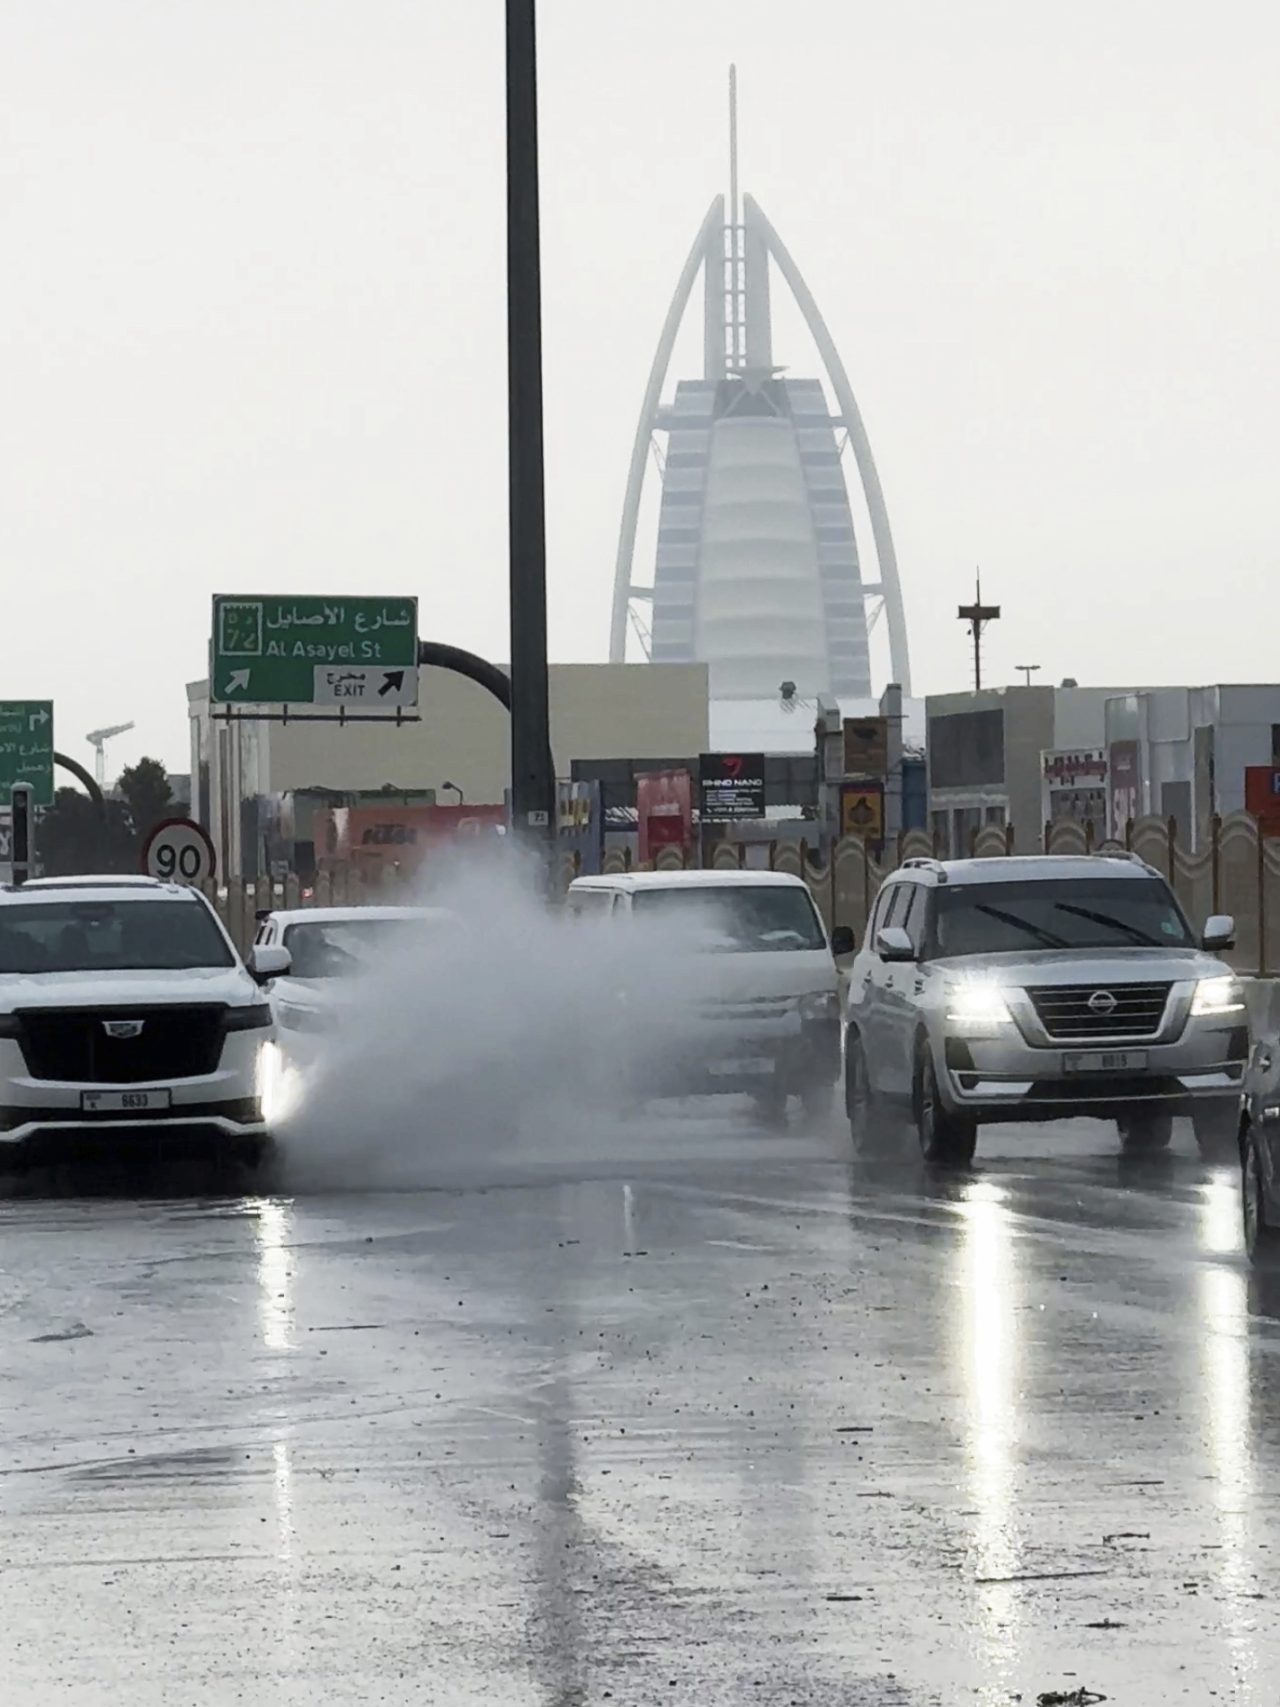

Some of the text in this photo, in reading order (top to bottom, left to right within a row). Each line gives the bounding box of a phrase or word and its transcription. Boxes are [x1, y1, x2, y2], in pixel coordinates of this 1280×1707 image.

[354, 608, 410, 633] شارع
[266, 641, 381, 661] Al Asayel St
[334, 685, 365, 697] EXIT
[157, 844, 201, 878] 90
